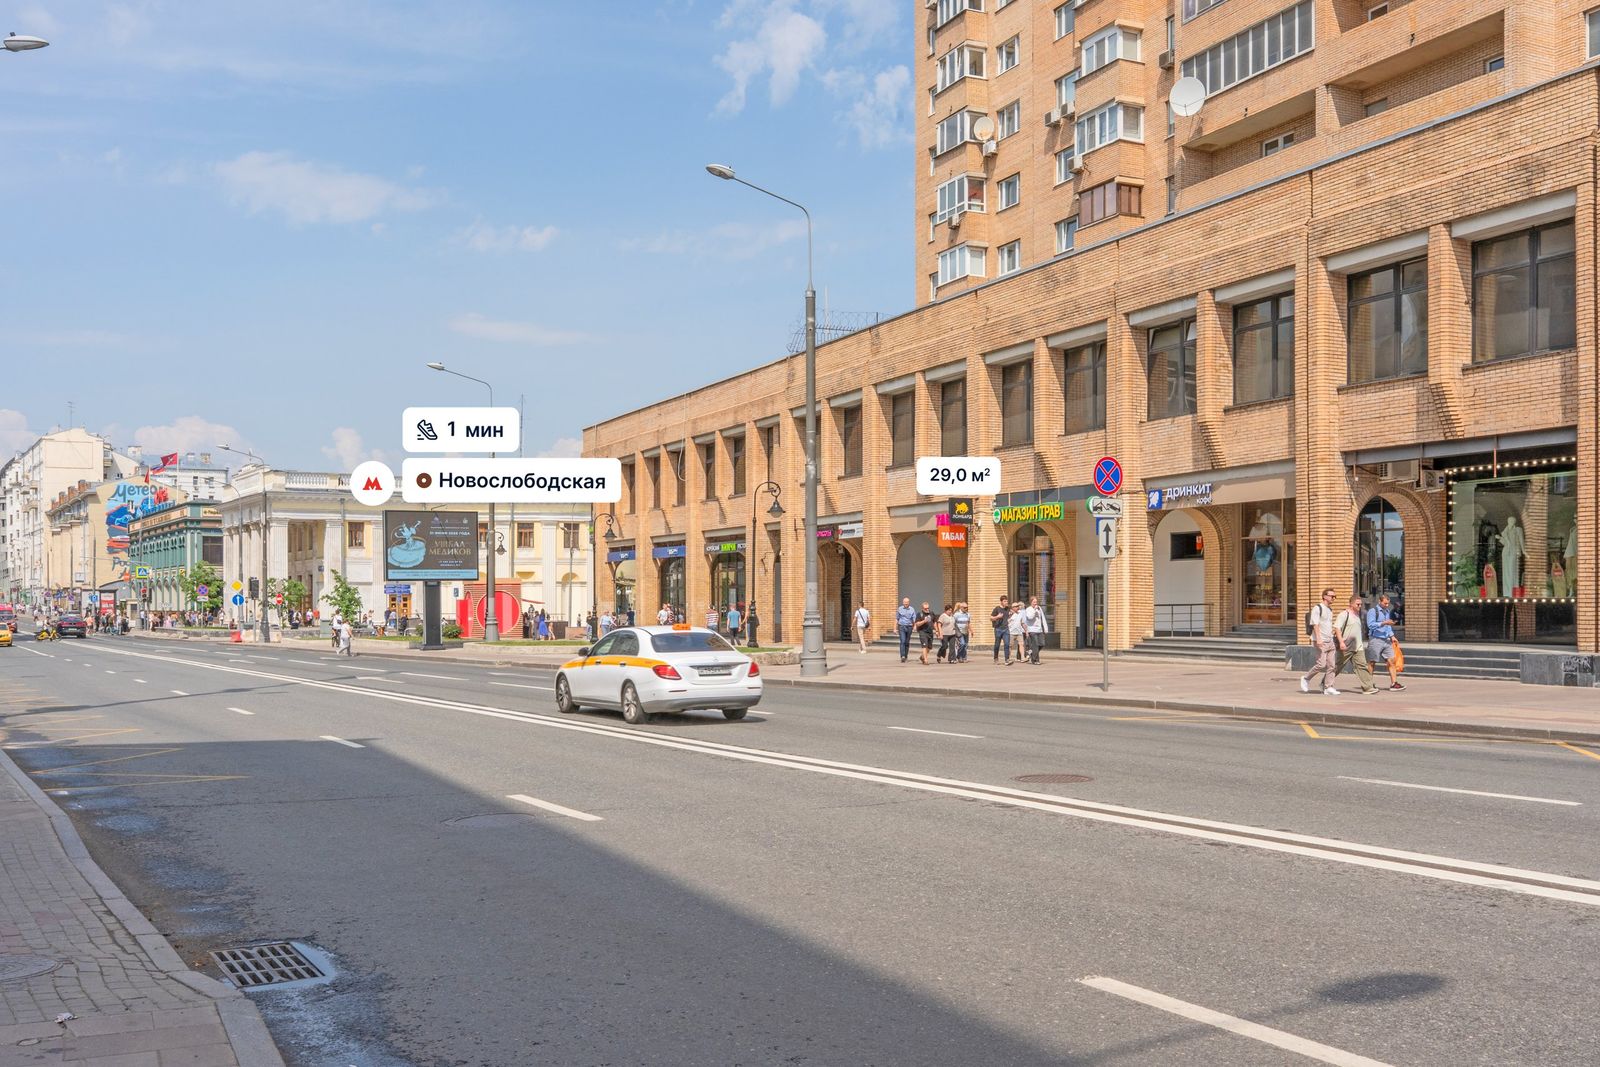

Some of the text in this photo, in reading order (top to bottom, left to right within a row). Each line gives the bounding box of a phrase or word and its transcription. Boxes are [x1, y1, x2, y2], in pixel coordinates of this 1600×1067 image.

[1001, 503, 1061, 522] МАГАЗИН ТРАВ
[941, 532, 965, 541] ТАБАК
